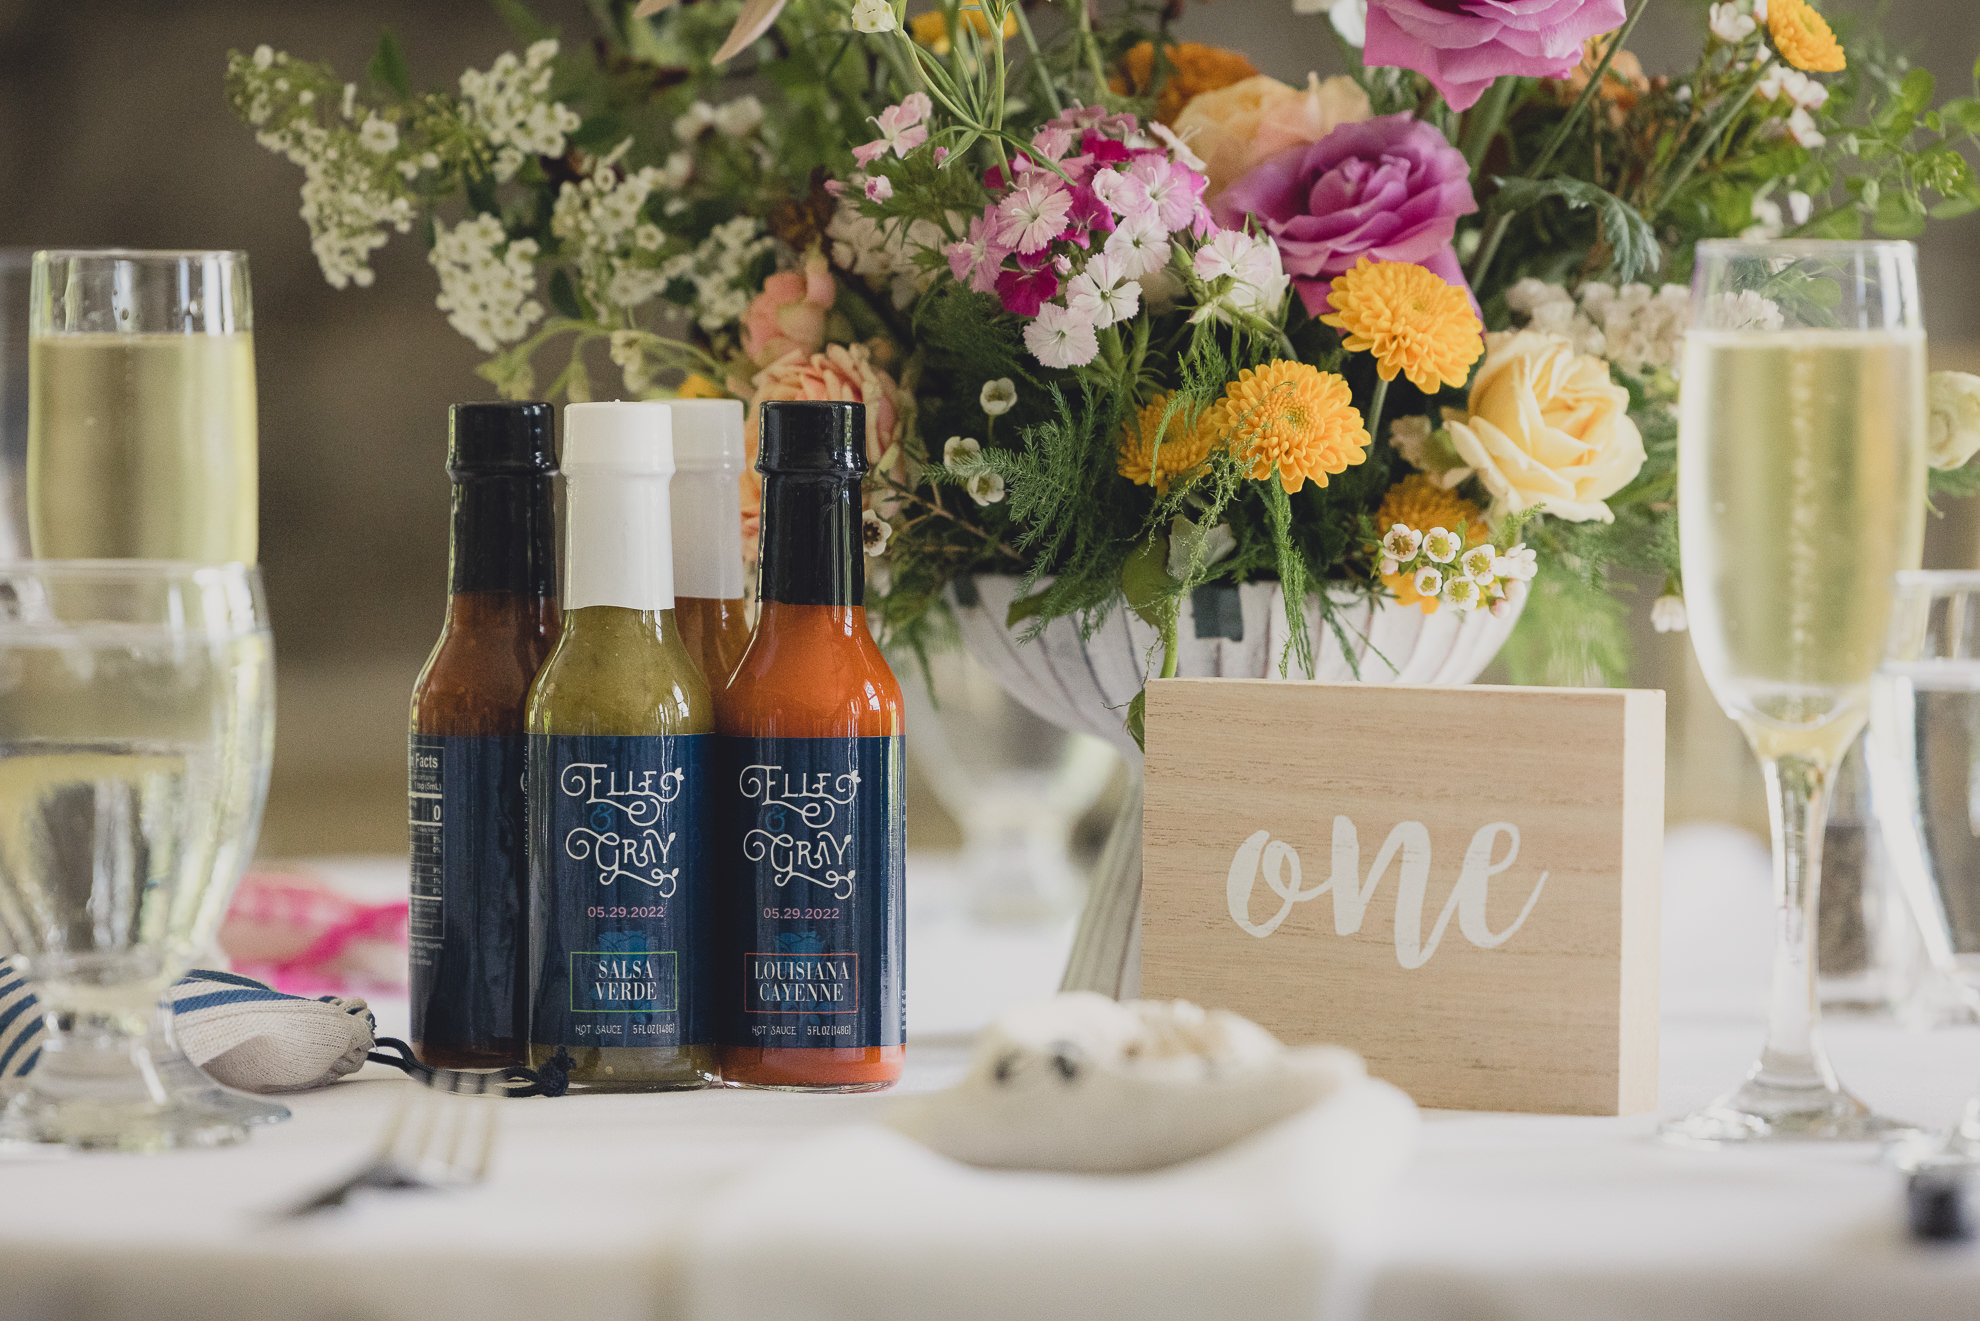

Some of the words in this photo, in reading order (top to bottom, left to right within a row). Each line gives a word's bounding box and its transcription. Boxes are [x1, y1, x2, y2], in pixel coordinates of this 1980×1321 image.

[415, 752, 438, 769] Facts
[433, 805, 441, 820] 0
[590, 803, 612, 831] &
[765, 805, 787, 832] &
[1226, 815, 1549, 970] one
[587, 906, 664, 918] 05.29.2022
[763, 907, 840, 919] 05.29.2022
[598, 960, 655, 979] SALSA
[754, 961, 850, 980] LOUISIANA
[595, 982, 658, 1001] VERDE
[759, 983, 844, 1002] CAYENNE
[575, 1024, 591, 1036] HOT
[595, 1024, 623, 1035] SAUCE
[751, 1025, 767, 1037] HOT
[770, 1025, 797, 1036] SAUCE
